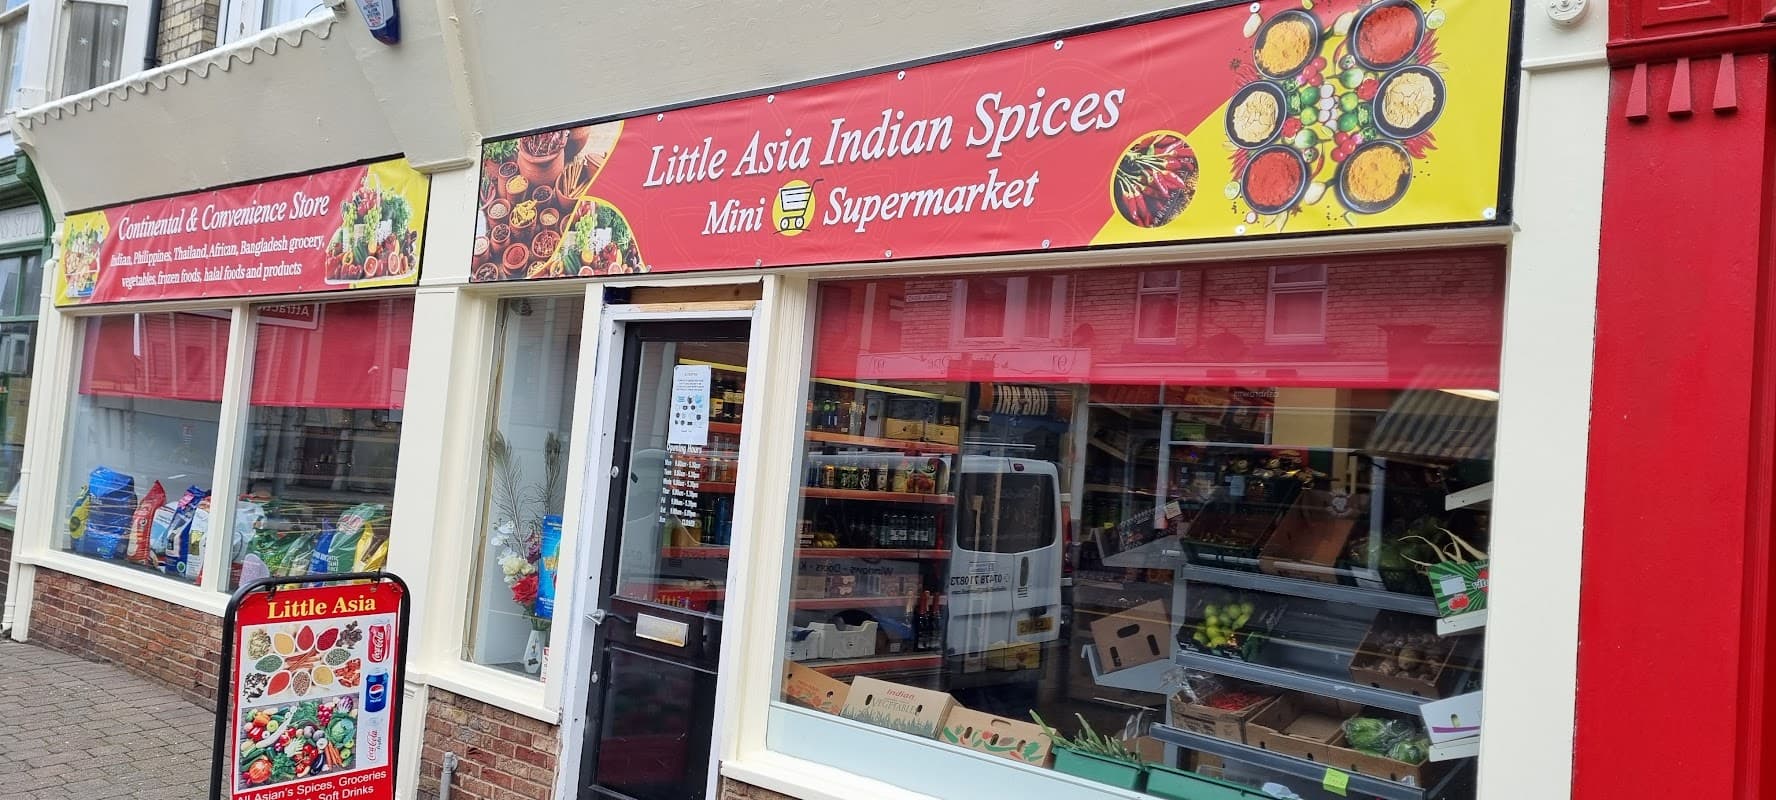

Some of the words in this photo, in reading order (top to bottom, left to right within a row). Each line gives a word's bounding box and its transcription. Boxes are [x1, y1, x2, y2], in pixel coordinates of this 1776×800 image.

[642, 138, 728, 189] Little
[732, 128, 810, 177] Asia
[820, 117, 953, 167] Indian
[965, 87, 1126, 160] Spices
[701, 197, 765, 236] Mini
[822, 168, 1040, 235] Supermarket
[118, 208, 183, 241] Continental
[186, 206, 199, 233] &
[201, 199, 286, 232] Convenience
[288, 190, 330, 221] Store
[173, 243, 209, 261] Thailand,
[209, 240, 239, 258] African,
[240, 235, 288, 255] Bangladesh
[157, 270, 180, 286] frozen
[204, 266, 223, 282] halal
[224, 263, 245, 280] foods
[245, 263, 263, 278] and
[263, 261, 302, 281] products
[267, 598, 327, 620] Little
[332, 595, 377, 614] Asia
[886, 687, 915, 701] Indian
[254, 788, 294, 800] Asian's
[296, 781, 336, 796] Spices,
[338, 770, 386, 787] Groceries
[341, 785, 375, 799] Drinks
